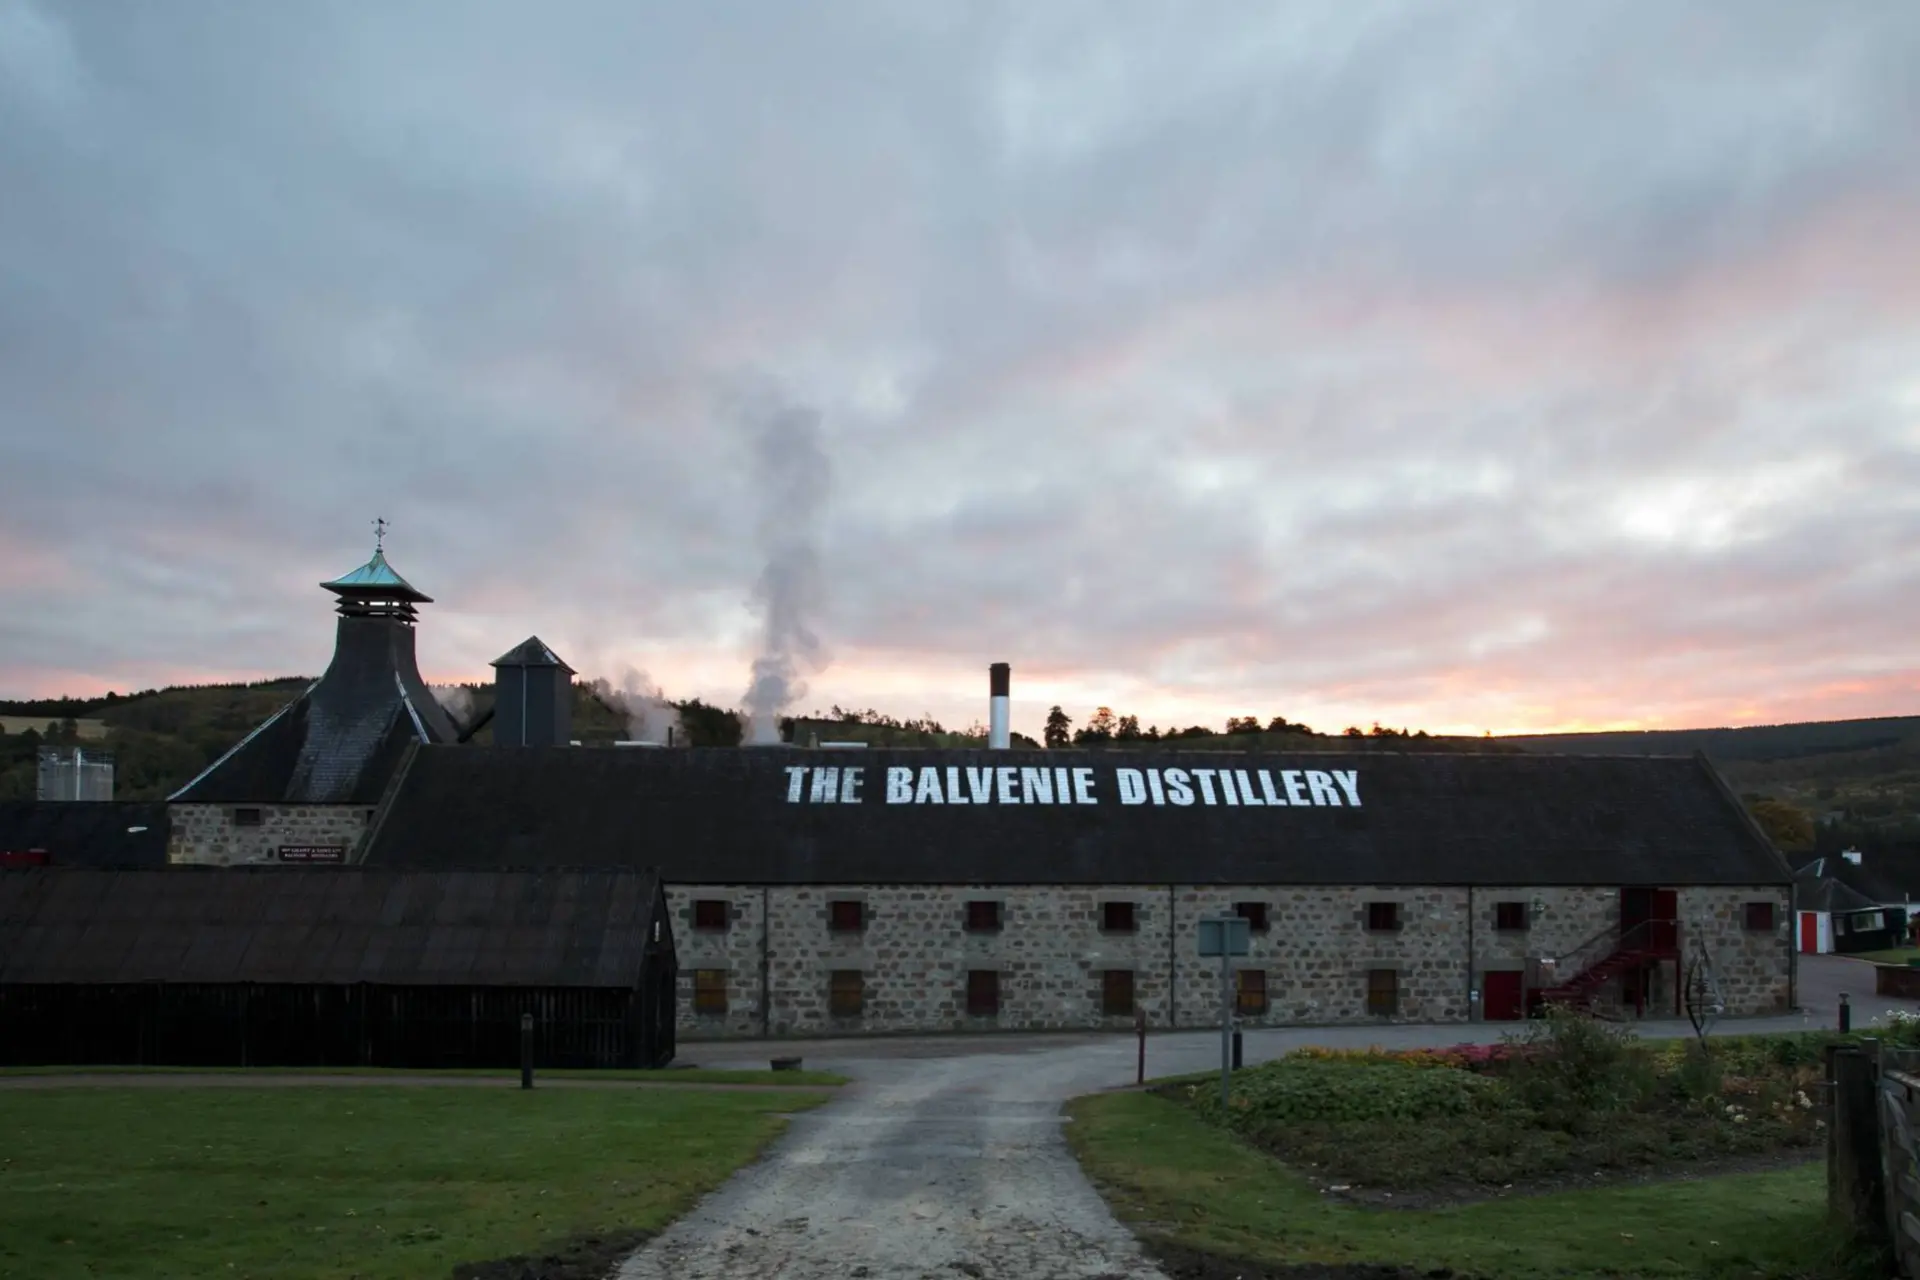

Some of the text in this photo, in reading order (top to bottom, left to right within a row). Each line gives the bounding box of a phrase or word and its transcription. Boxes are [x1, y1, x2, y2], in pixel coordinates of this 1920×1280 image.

[784, 766, 1362, 807] THE BALVENIE DISTILLERY
